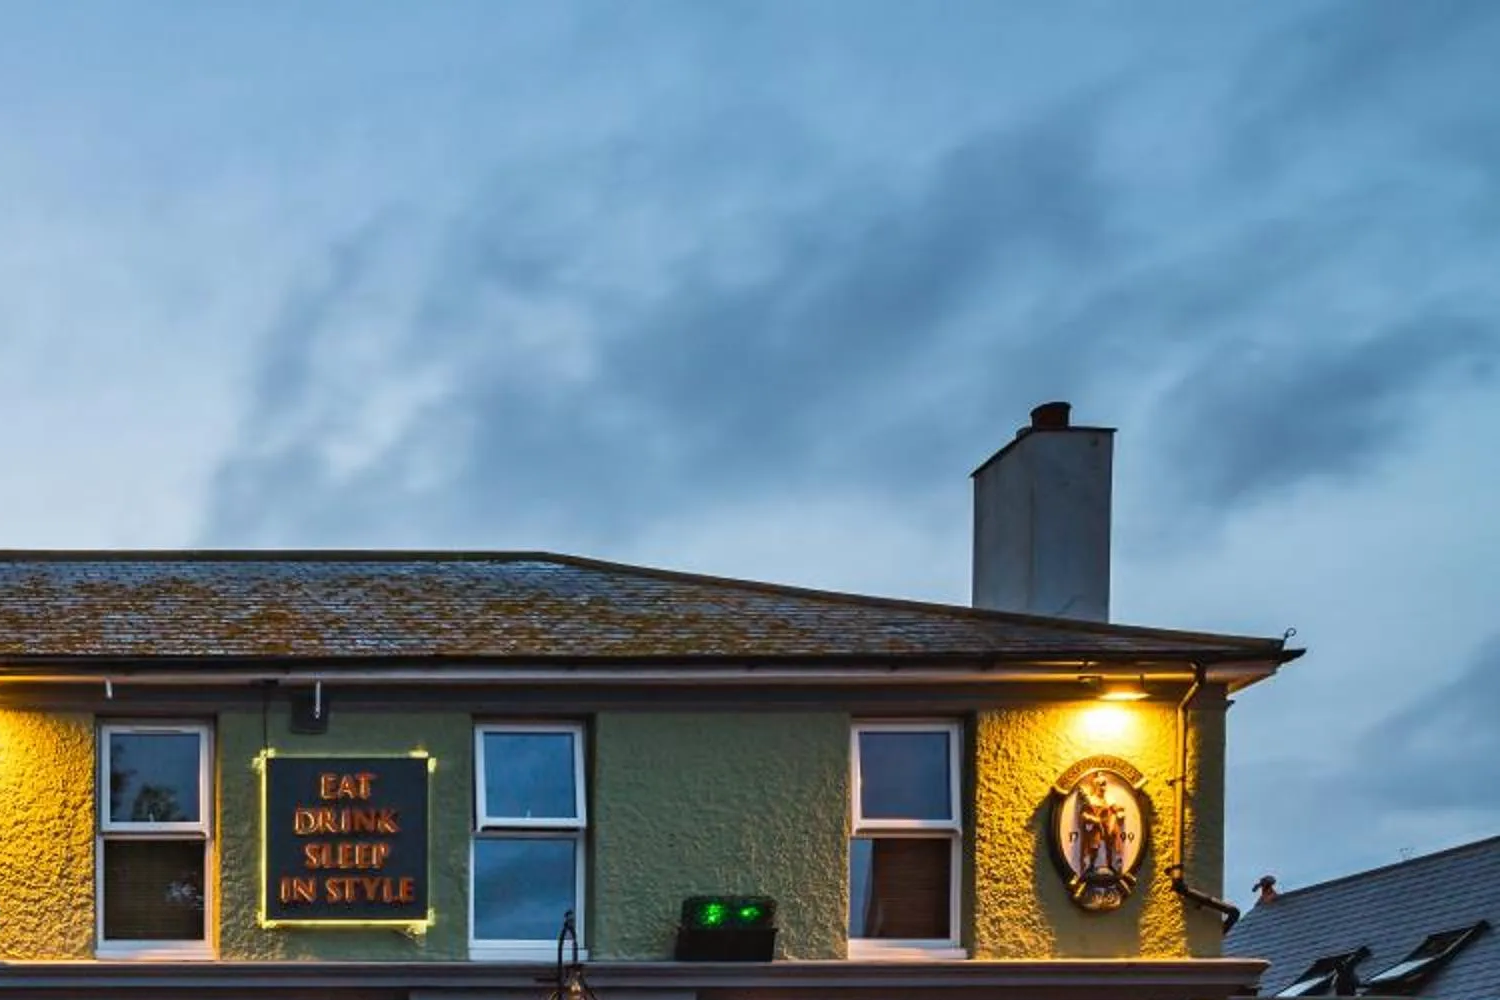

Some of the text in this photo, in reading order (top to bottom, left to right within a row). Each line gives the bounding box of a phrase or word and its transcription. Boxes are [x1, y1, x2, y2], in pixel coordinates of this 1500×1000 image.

[320, 771, 377, 800] EAT
[294, 805, 400, 835] DRINK
[304, 841, 389, 870] SLEEP
[280, 876, 415, 904] IN STYLE
